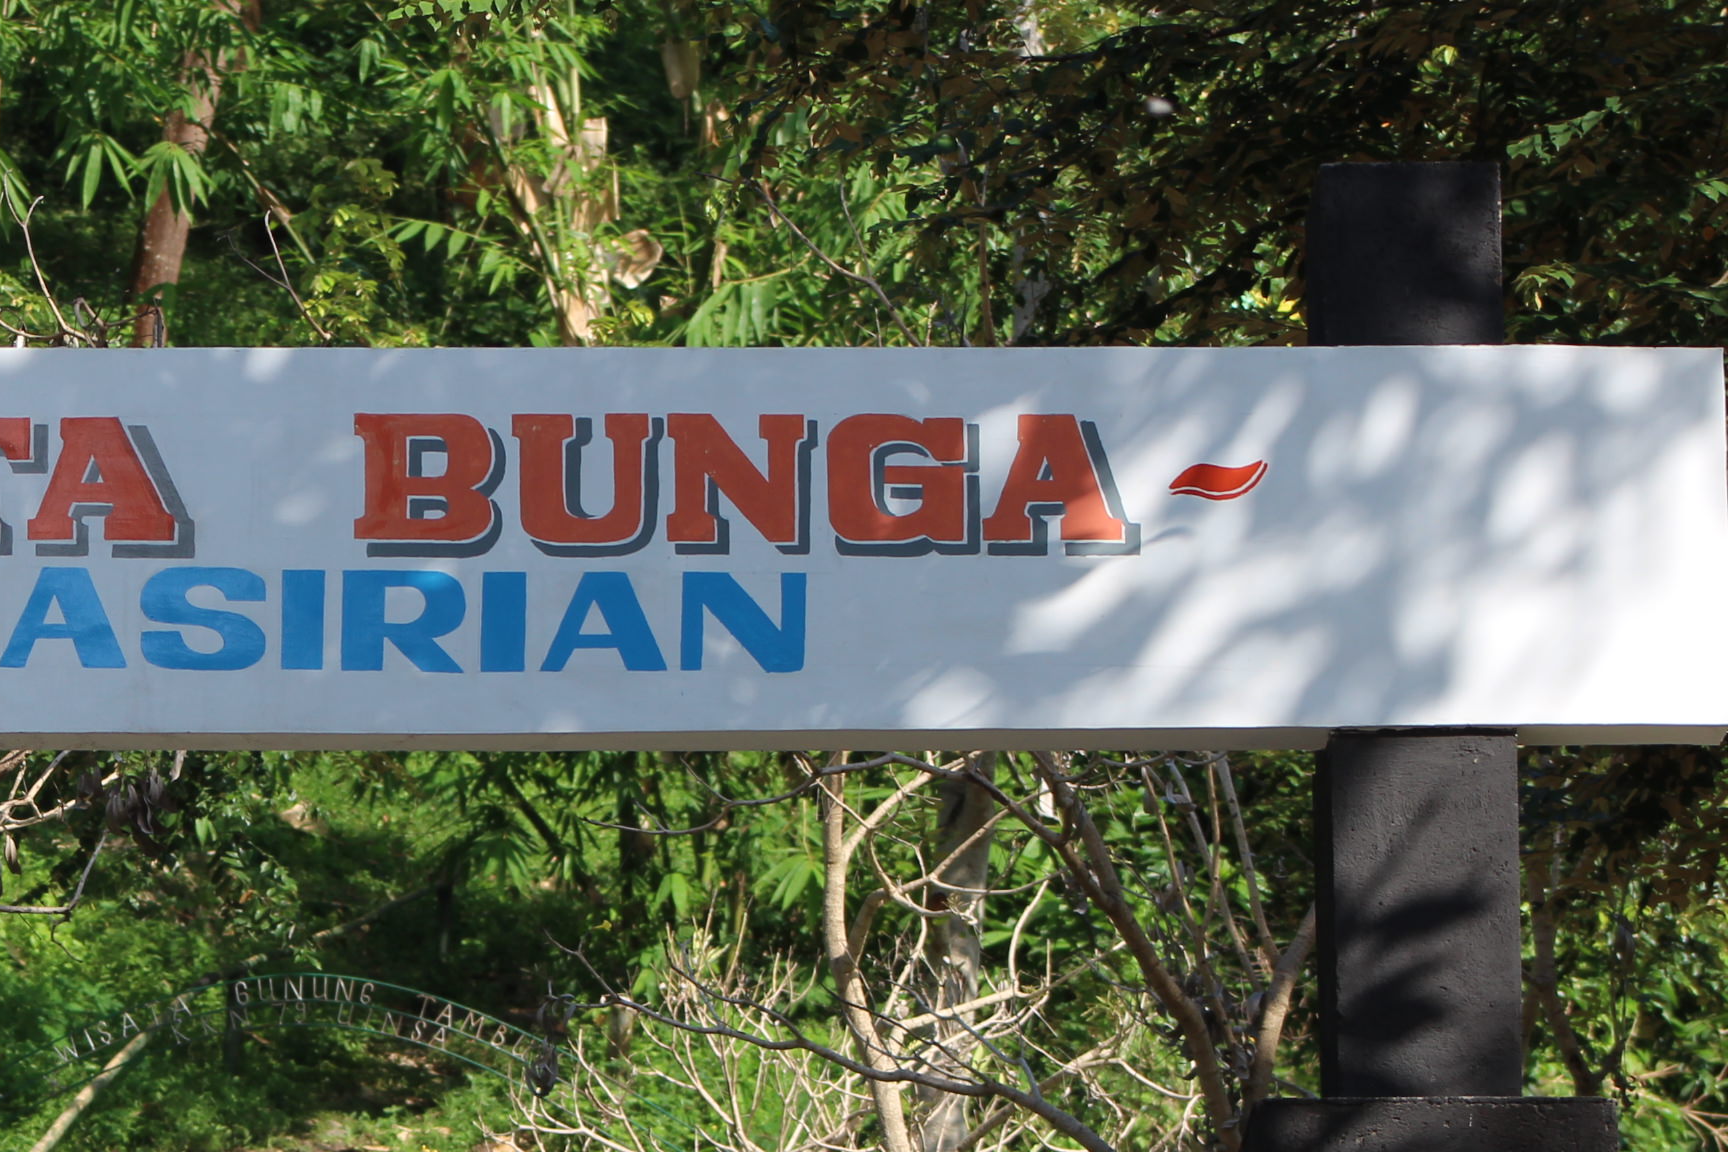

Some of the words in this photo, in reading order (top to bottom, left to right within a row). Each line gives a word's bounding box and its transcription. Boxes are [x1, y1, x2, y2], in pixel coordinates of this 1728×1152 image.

[352, 413, 1140, 557] BUNGA
[53, 995, 193, 1062] WISATA
[234, 975, 375, 1006] GUNUNG
[337, 1002, 447, 1050] UINSA
